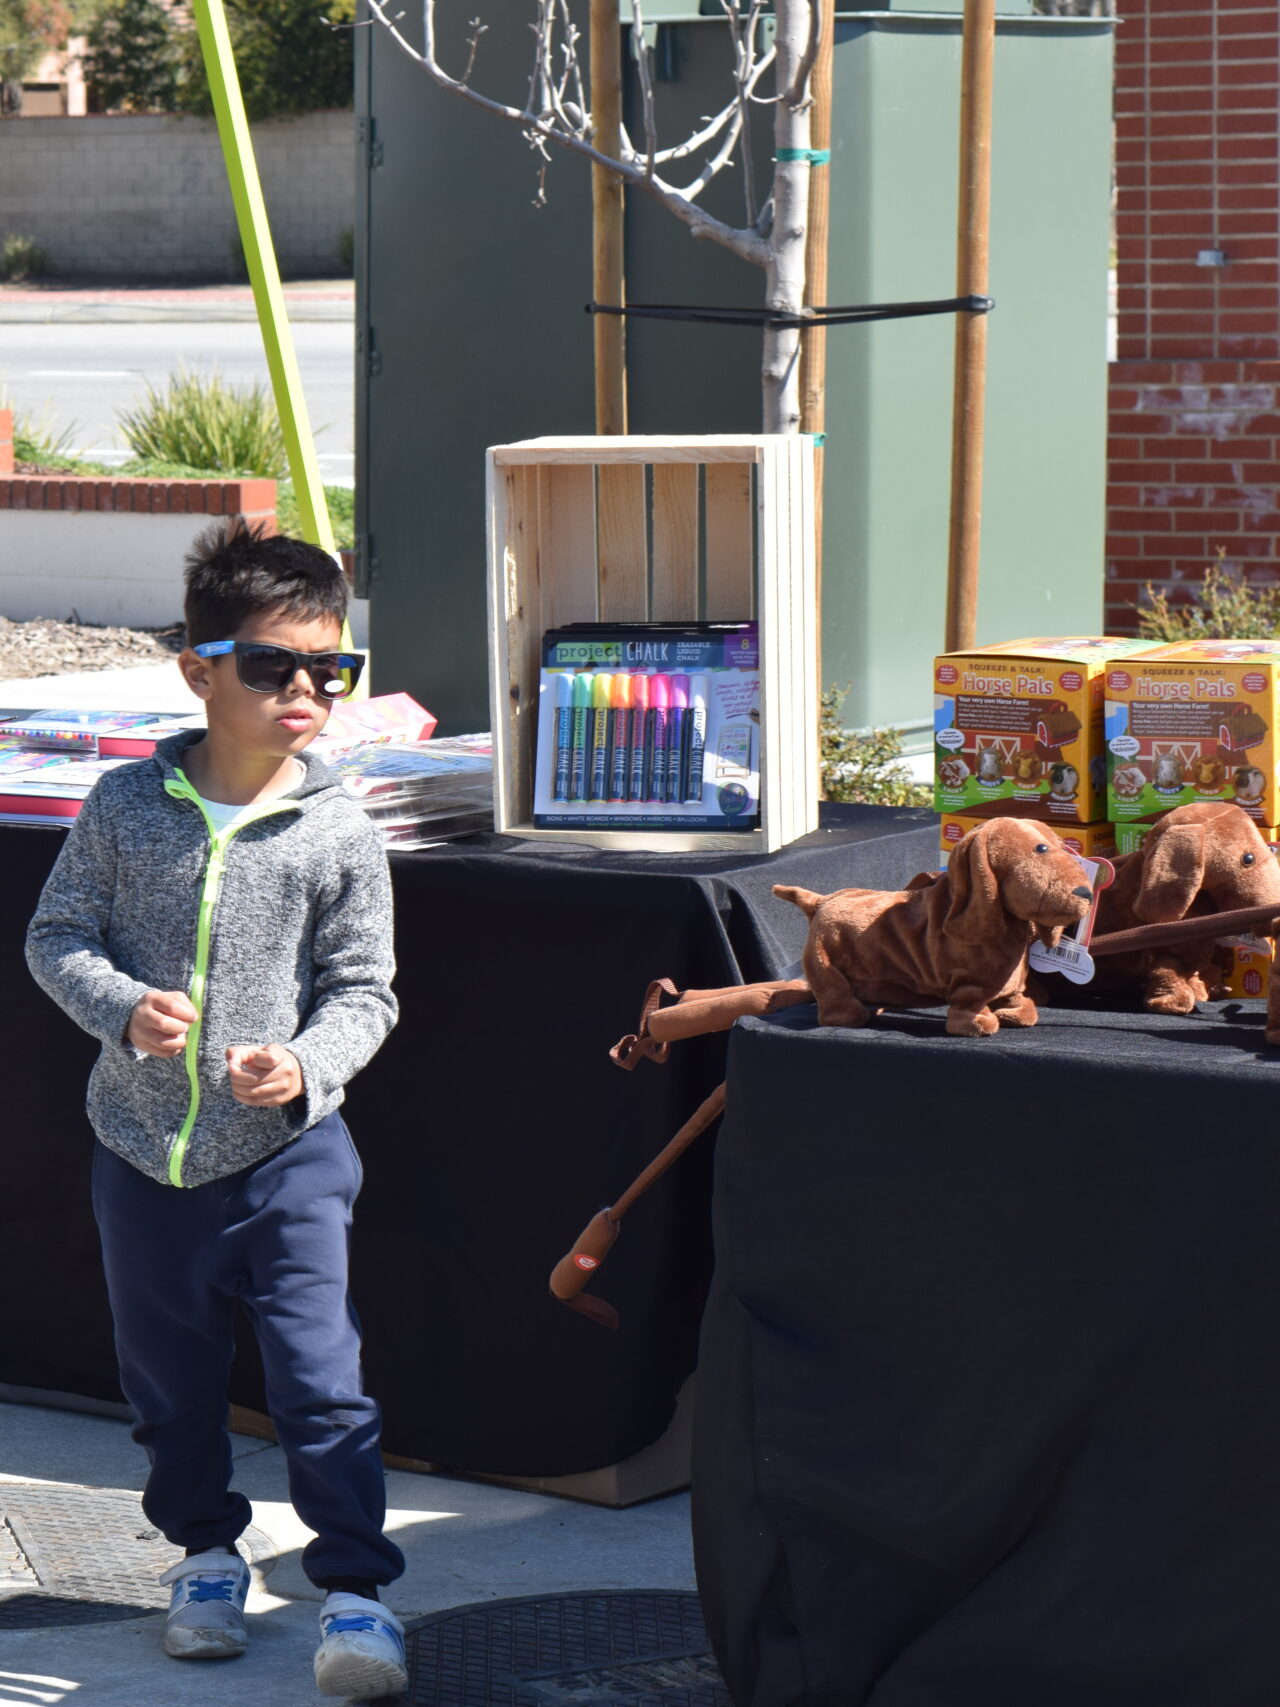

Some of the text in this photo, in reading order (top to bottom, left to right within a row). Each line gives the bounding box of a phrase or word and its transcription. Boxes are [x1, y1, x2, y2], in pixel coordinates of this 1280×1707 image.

[557, 641, 669, 661] project CHALK
[741, 638, 750, 650] 8
[968, 664, 1007, 672] SQUEEZE
[1142, 668, 1185, 676] SQUEEZE
[962, 672, 1012, 693] Horse
[1016, 674, 1054, 696] Pals
[1136, 677, 1236, 699] Horse Pals
[996, 697, 1012, 705] Horse
[1013, 698, 1029, 706] Farm!
[593, 711, 605, 774] project CHALK
[691, 711, 703, 774] project CHALK
[558, 749, 568, 774] CHALK
[572, 749, 583, 774] CHALK
[614, 749, 625, 774] CHALK
[632, 749, 643, 774] CHALK
[653, 749, 664, 774] CHALK
[668, 749, 679, 774] CHALK
